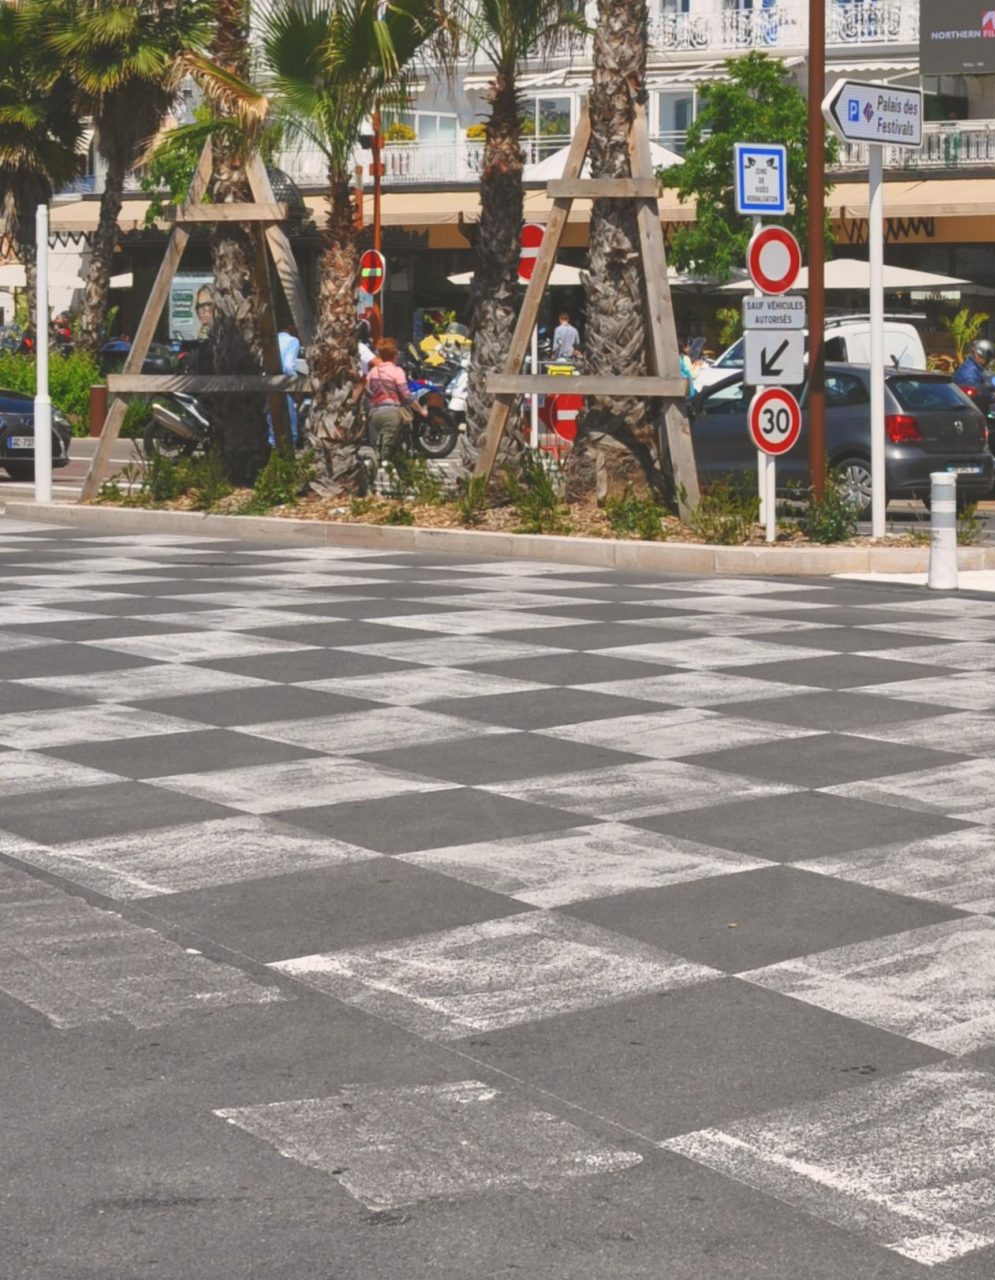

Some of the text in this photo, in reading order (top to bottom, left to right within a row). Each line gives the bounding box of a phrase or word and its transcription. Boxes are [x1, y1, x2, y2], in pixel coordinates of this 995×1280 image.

[931, 29, 981, 40] NORTHERN
[877, 95, 918, 115] Palais des
[877, 117, 914, 136] Festivals
[746, 299, 804, 310] SAUF VÉHICULES
[755, 314, 793, 324] AUTORISÉS
[762, 408, 790, 434] 30
